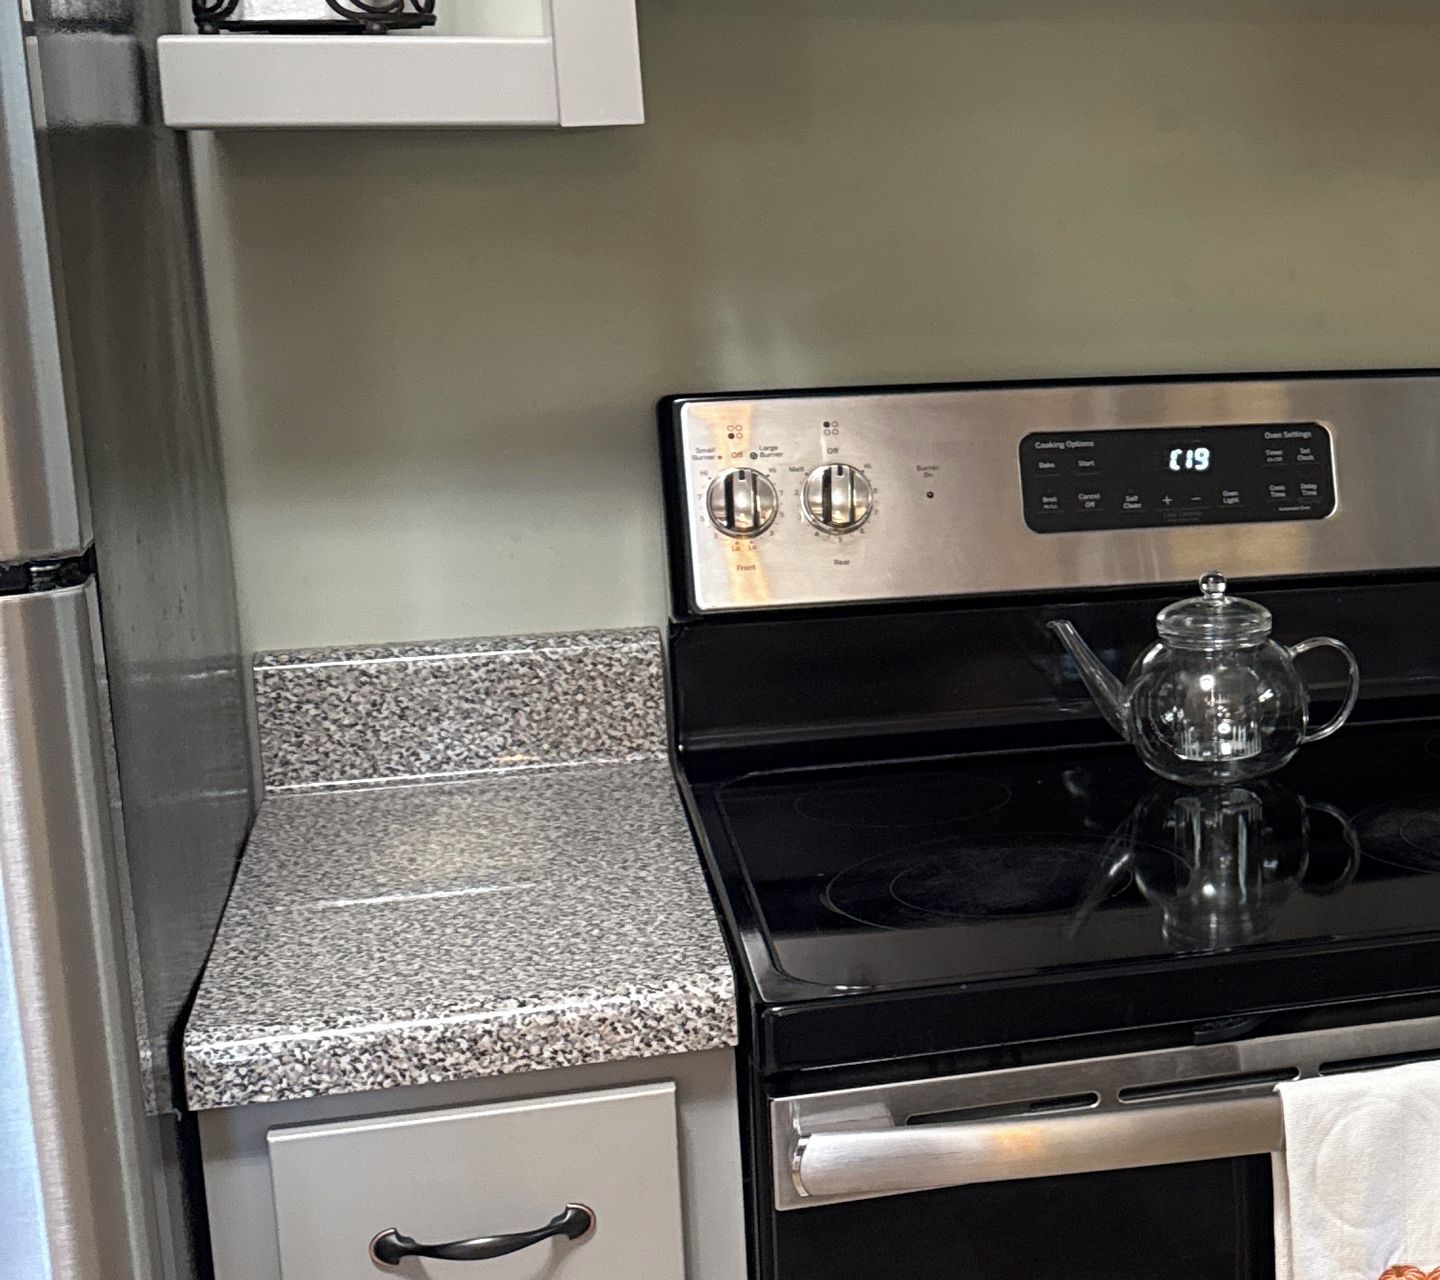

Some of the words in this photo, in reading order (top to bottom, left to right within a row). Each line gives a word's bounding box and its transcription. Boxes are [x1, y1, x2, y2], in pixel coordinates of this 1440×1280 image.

[1264, 431, 1282, 439] Oven
[1283, 430, 1312, 439] Settings
[758, 445, 779, 453] Large
[1035, 441, 1065, 450] Cooking
[1066, 440, 1095, 449] Options
[731, 451, 743, 459] Off
[759, 451, 783, 459] Burner
[827, 447, 839, 455] Off
[736, 564, 756, 572] Front
